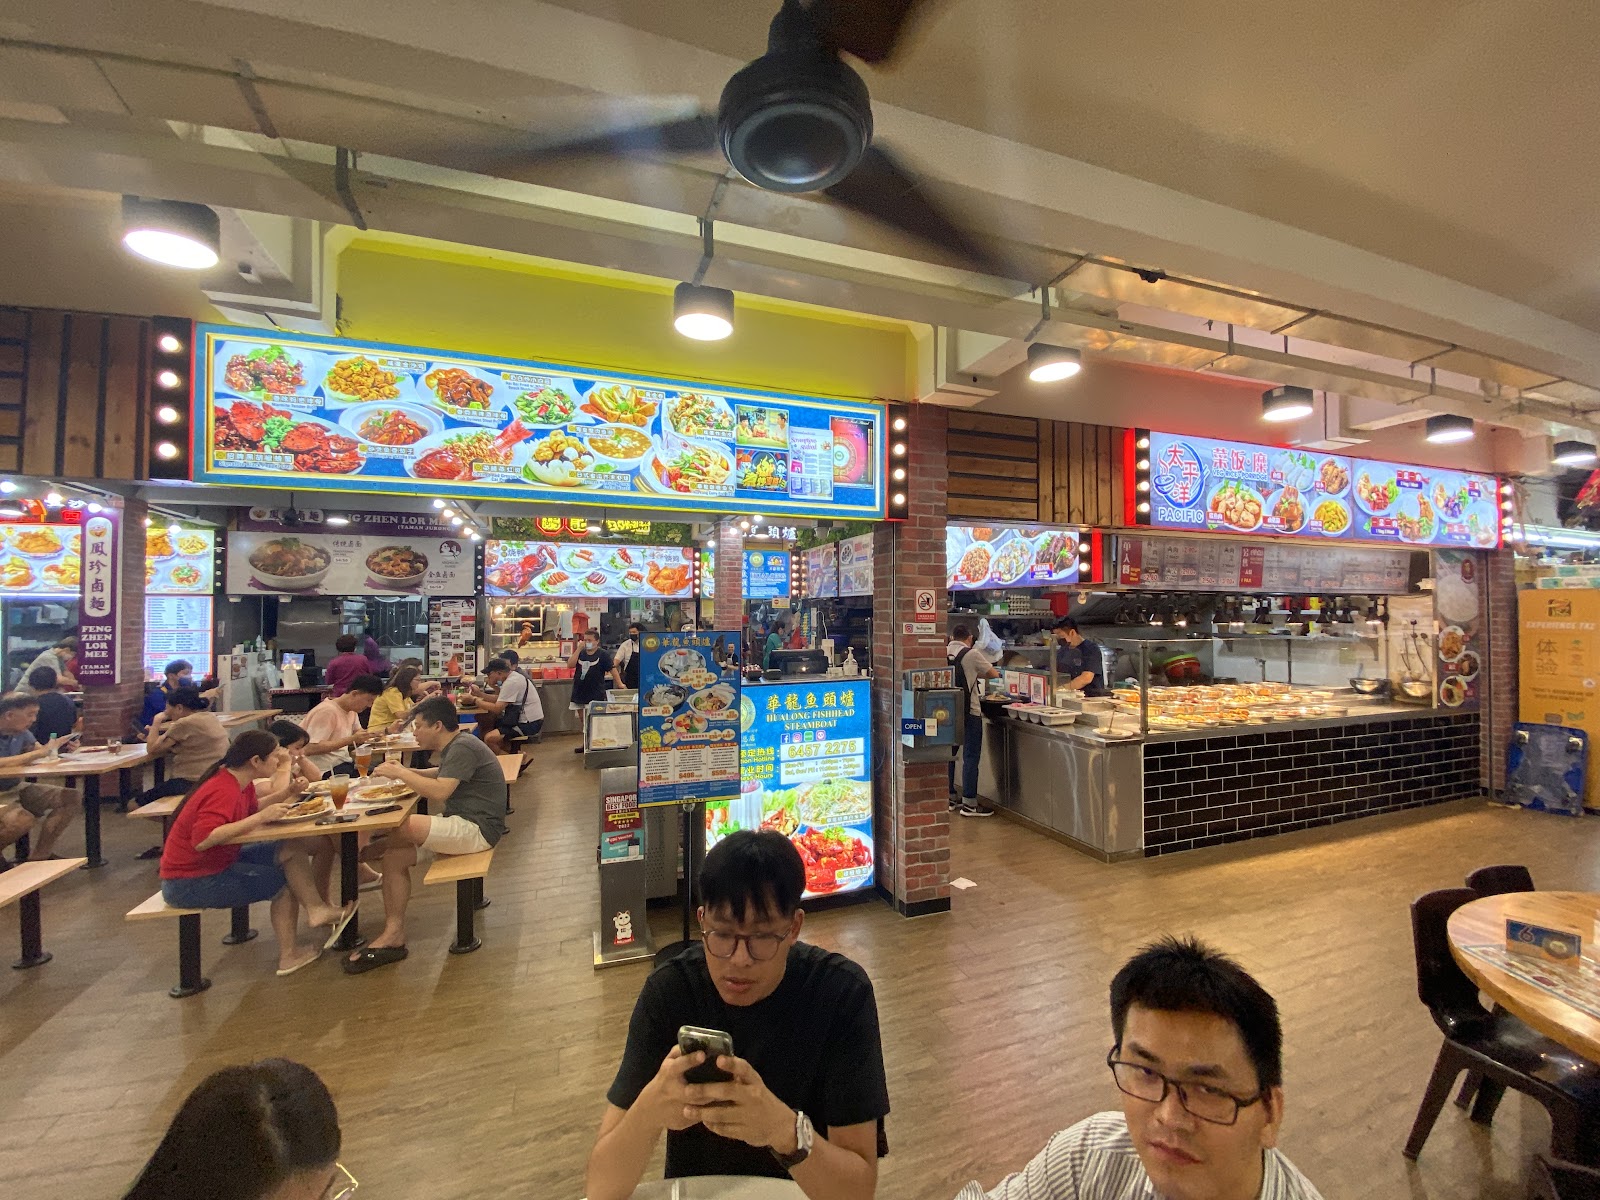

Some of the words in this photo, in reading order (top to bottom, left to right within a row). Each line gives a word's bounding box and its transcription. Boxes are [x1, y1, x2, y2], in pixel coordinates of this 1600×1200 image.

[1167, 444, 1199, 506] 太平洋
[1213, 470, 1224, 478] VEG
[364, 514, 398, 524] ZHEN
[402, 516, 426, 526] LOR
[1158, 506, 1204, 522] PACIFIC
[1526, 622, 1576, 630] EXPERIENCE
[86, 642, 108, 650] LOR
[766, 690, 855, 712] 華龍魚頭爐
[766, 712, 811, 722] HUALONG
[812, 709, 855, 719] FISHHEAD
[784, 720, 838, 730] STEAMBOAT
[788, 744, 820, 758] 6457
[824, 740, 857, 756] 2275
[606, 794, 637, 804] SINGAPOR
[606, 803, 620, 812] BEST
[1519, 926, 1535, 943] 6
